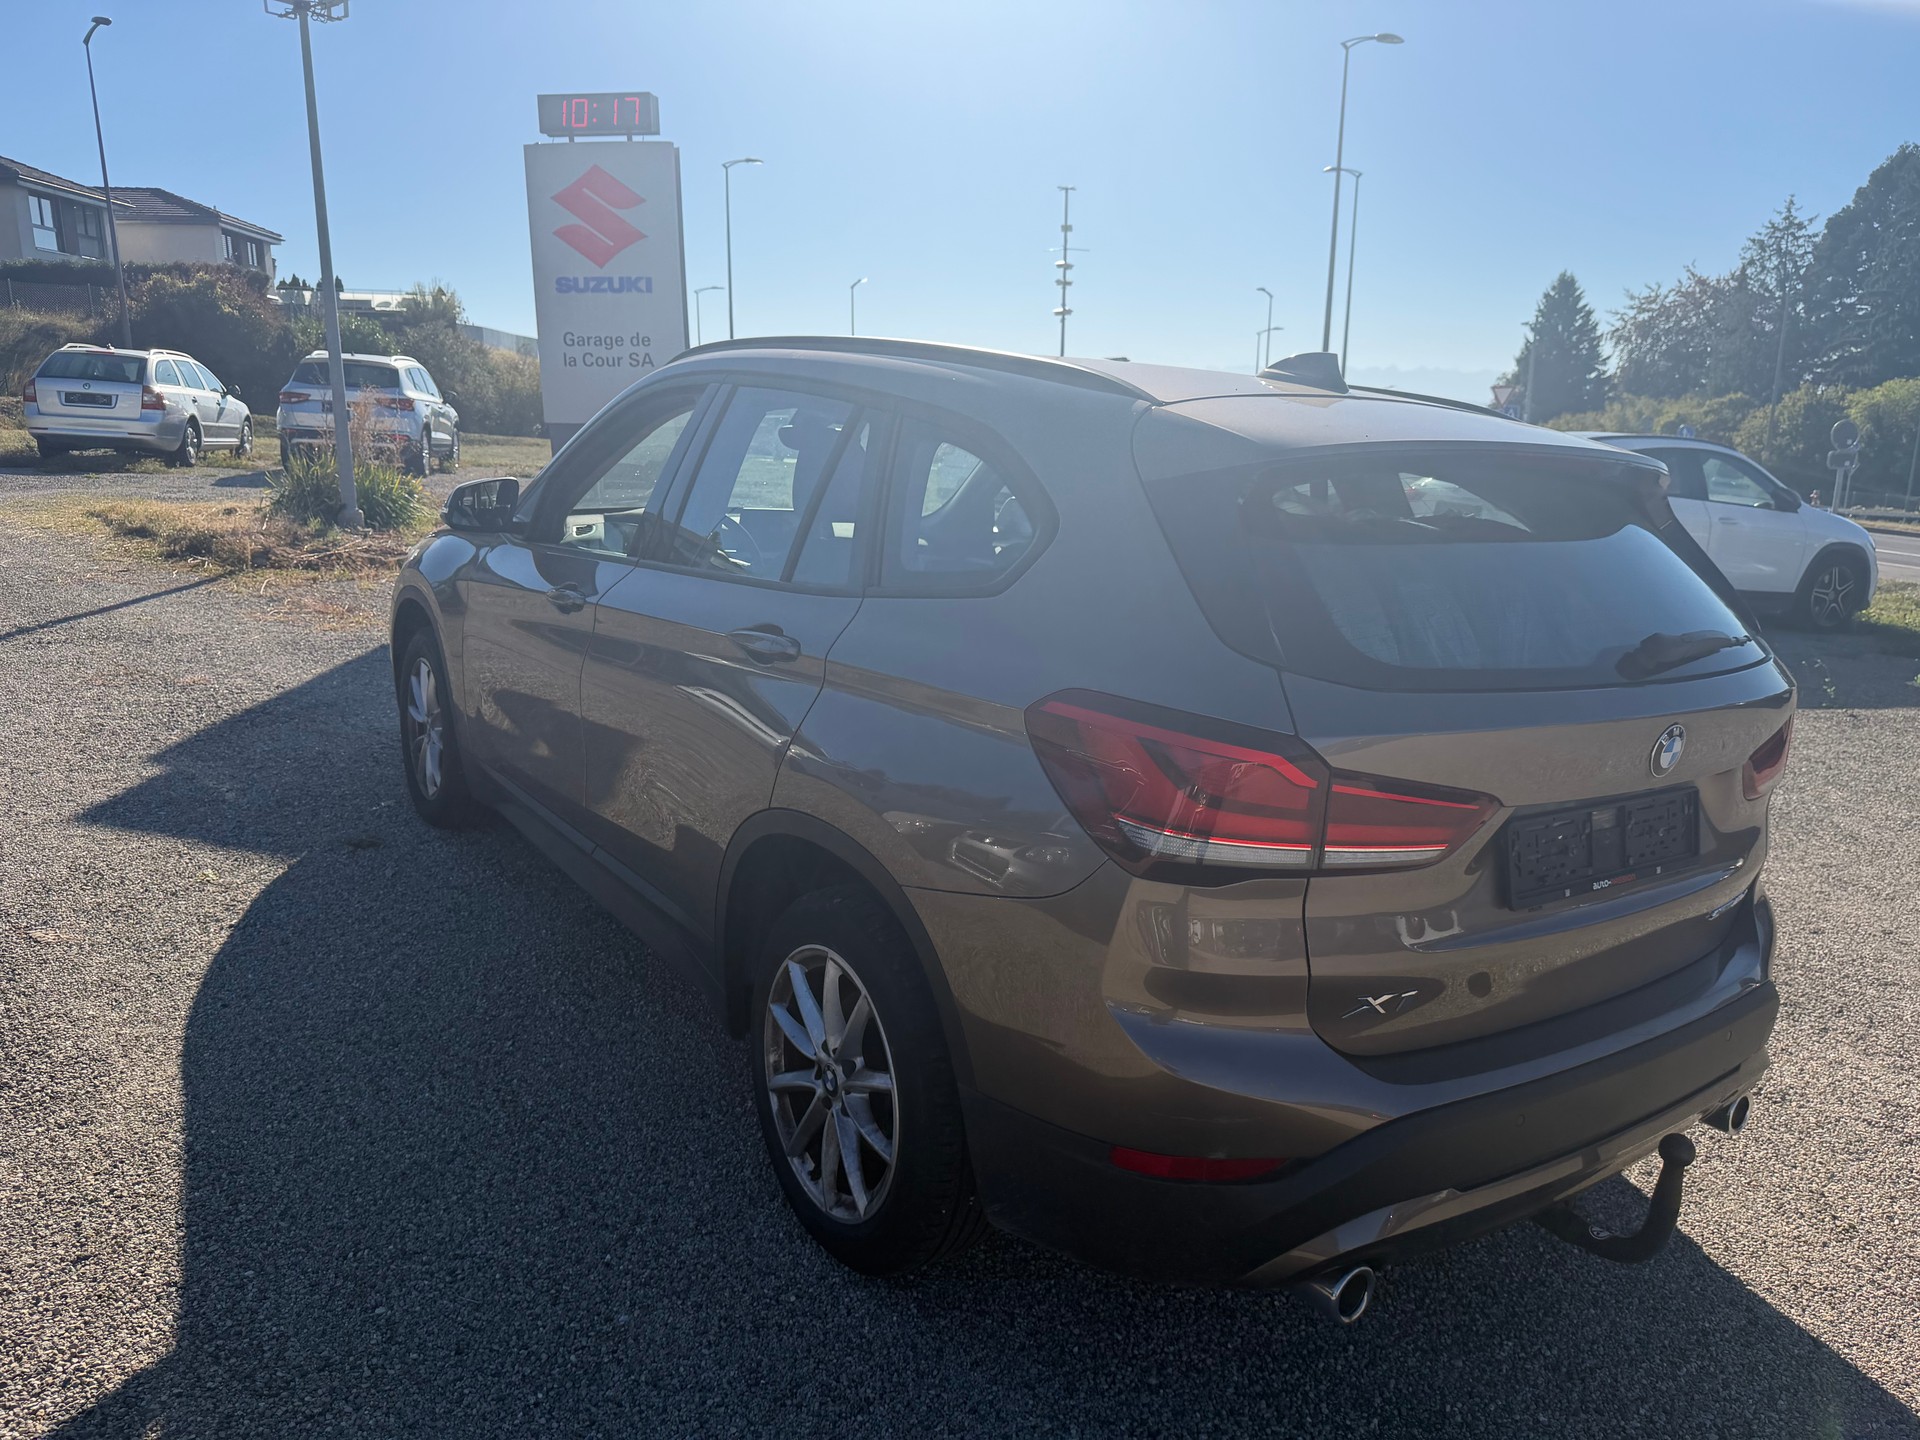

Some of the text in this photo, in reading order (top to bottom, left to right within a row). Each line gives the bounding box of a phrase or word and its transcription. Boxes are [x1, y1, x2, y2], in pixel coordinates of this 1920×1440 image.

[562, 97, 640, 128] 10:17
[555, 276, 653, 294] SUZUKI
[563, 331, 651, 350] Garage de
[563, 352, 655, 367] la Cour SA
